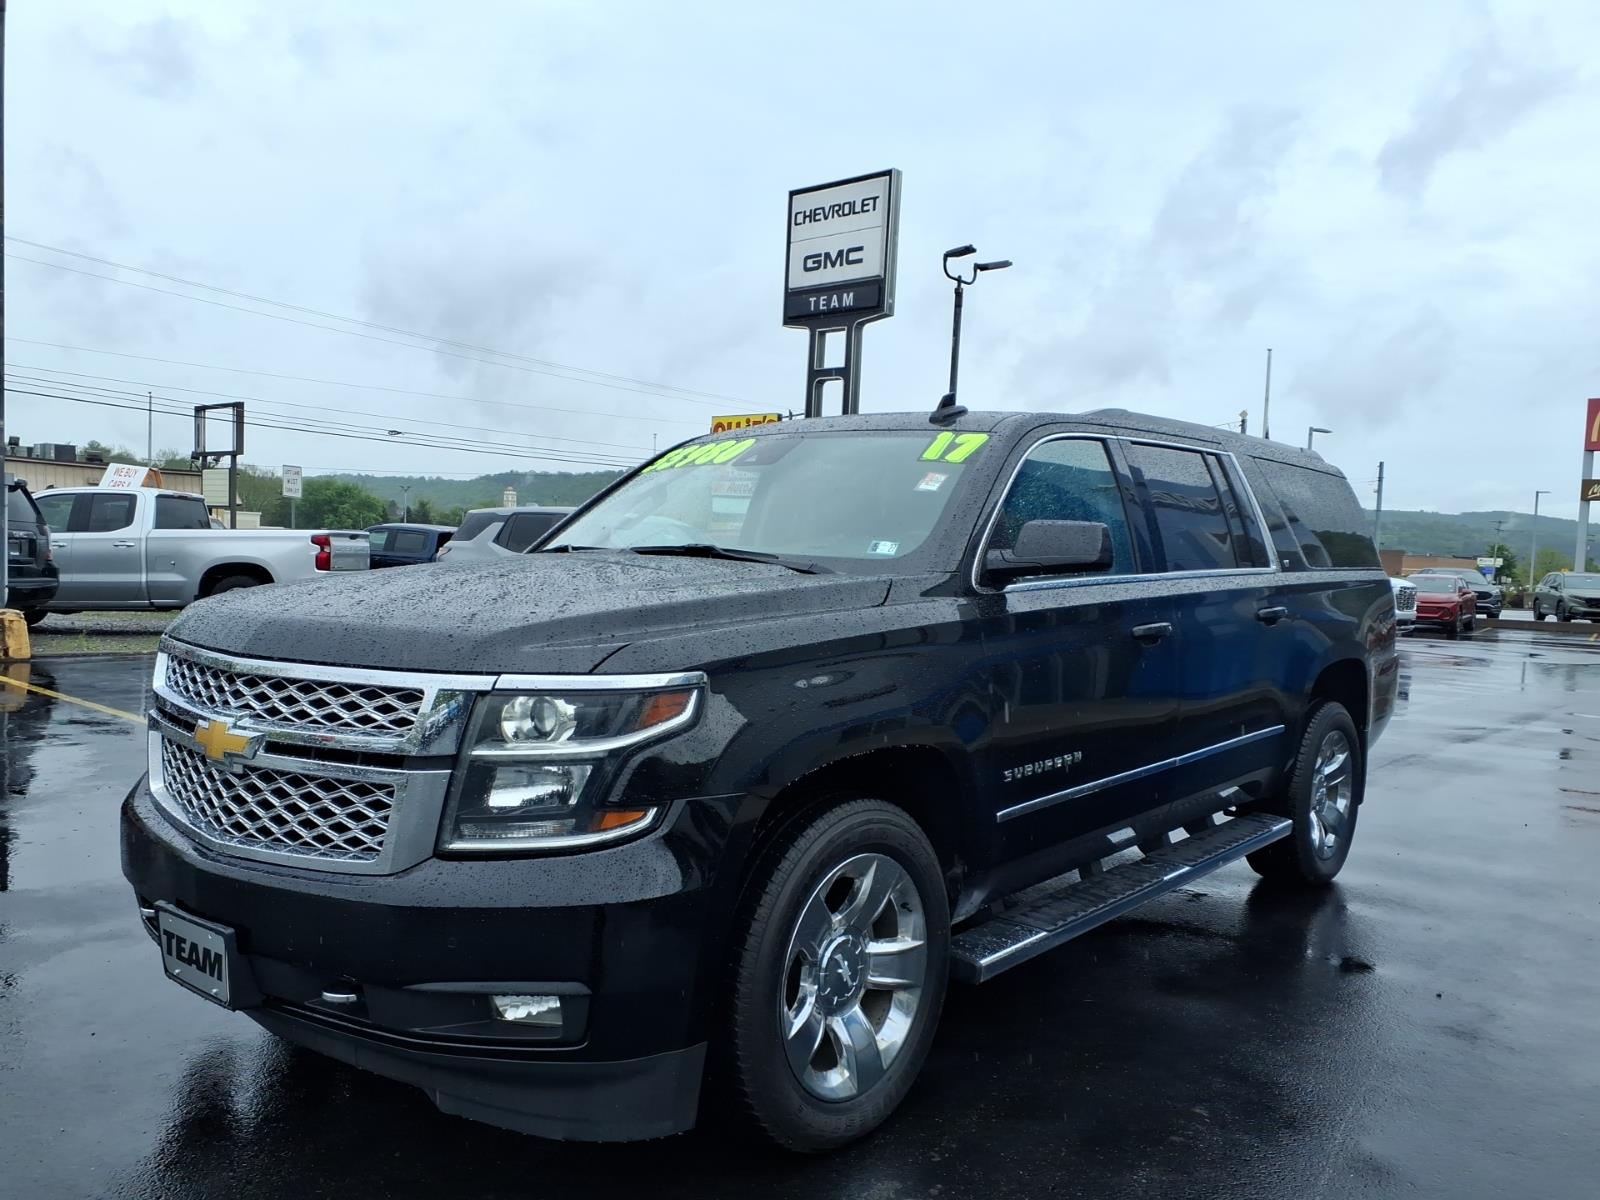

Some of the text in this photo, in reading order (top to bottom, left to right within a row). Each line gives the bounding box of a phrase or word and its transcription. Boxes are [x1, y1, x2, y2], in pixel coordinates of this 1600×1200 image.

[794, 196, 880, 226] CHEVROLET
[803, 246, 864, 272] GMC
[809, 292, 854, 311] TEAM
[921, 431, 990, 463] 17
[162, 928, 224, 983] TEAM
